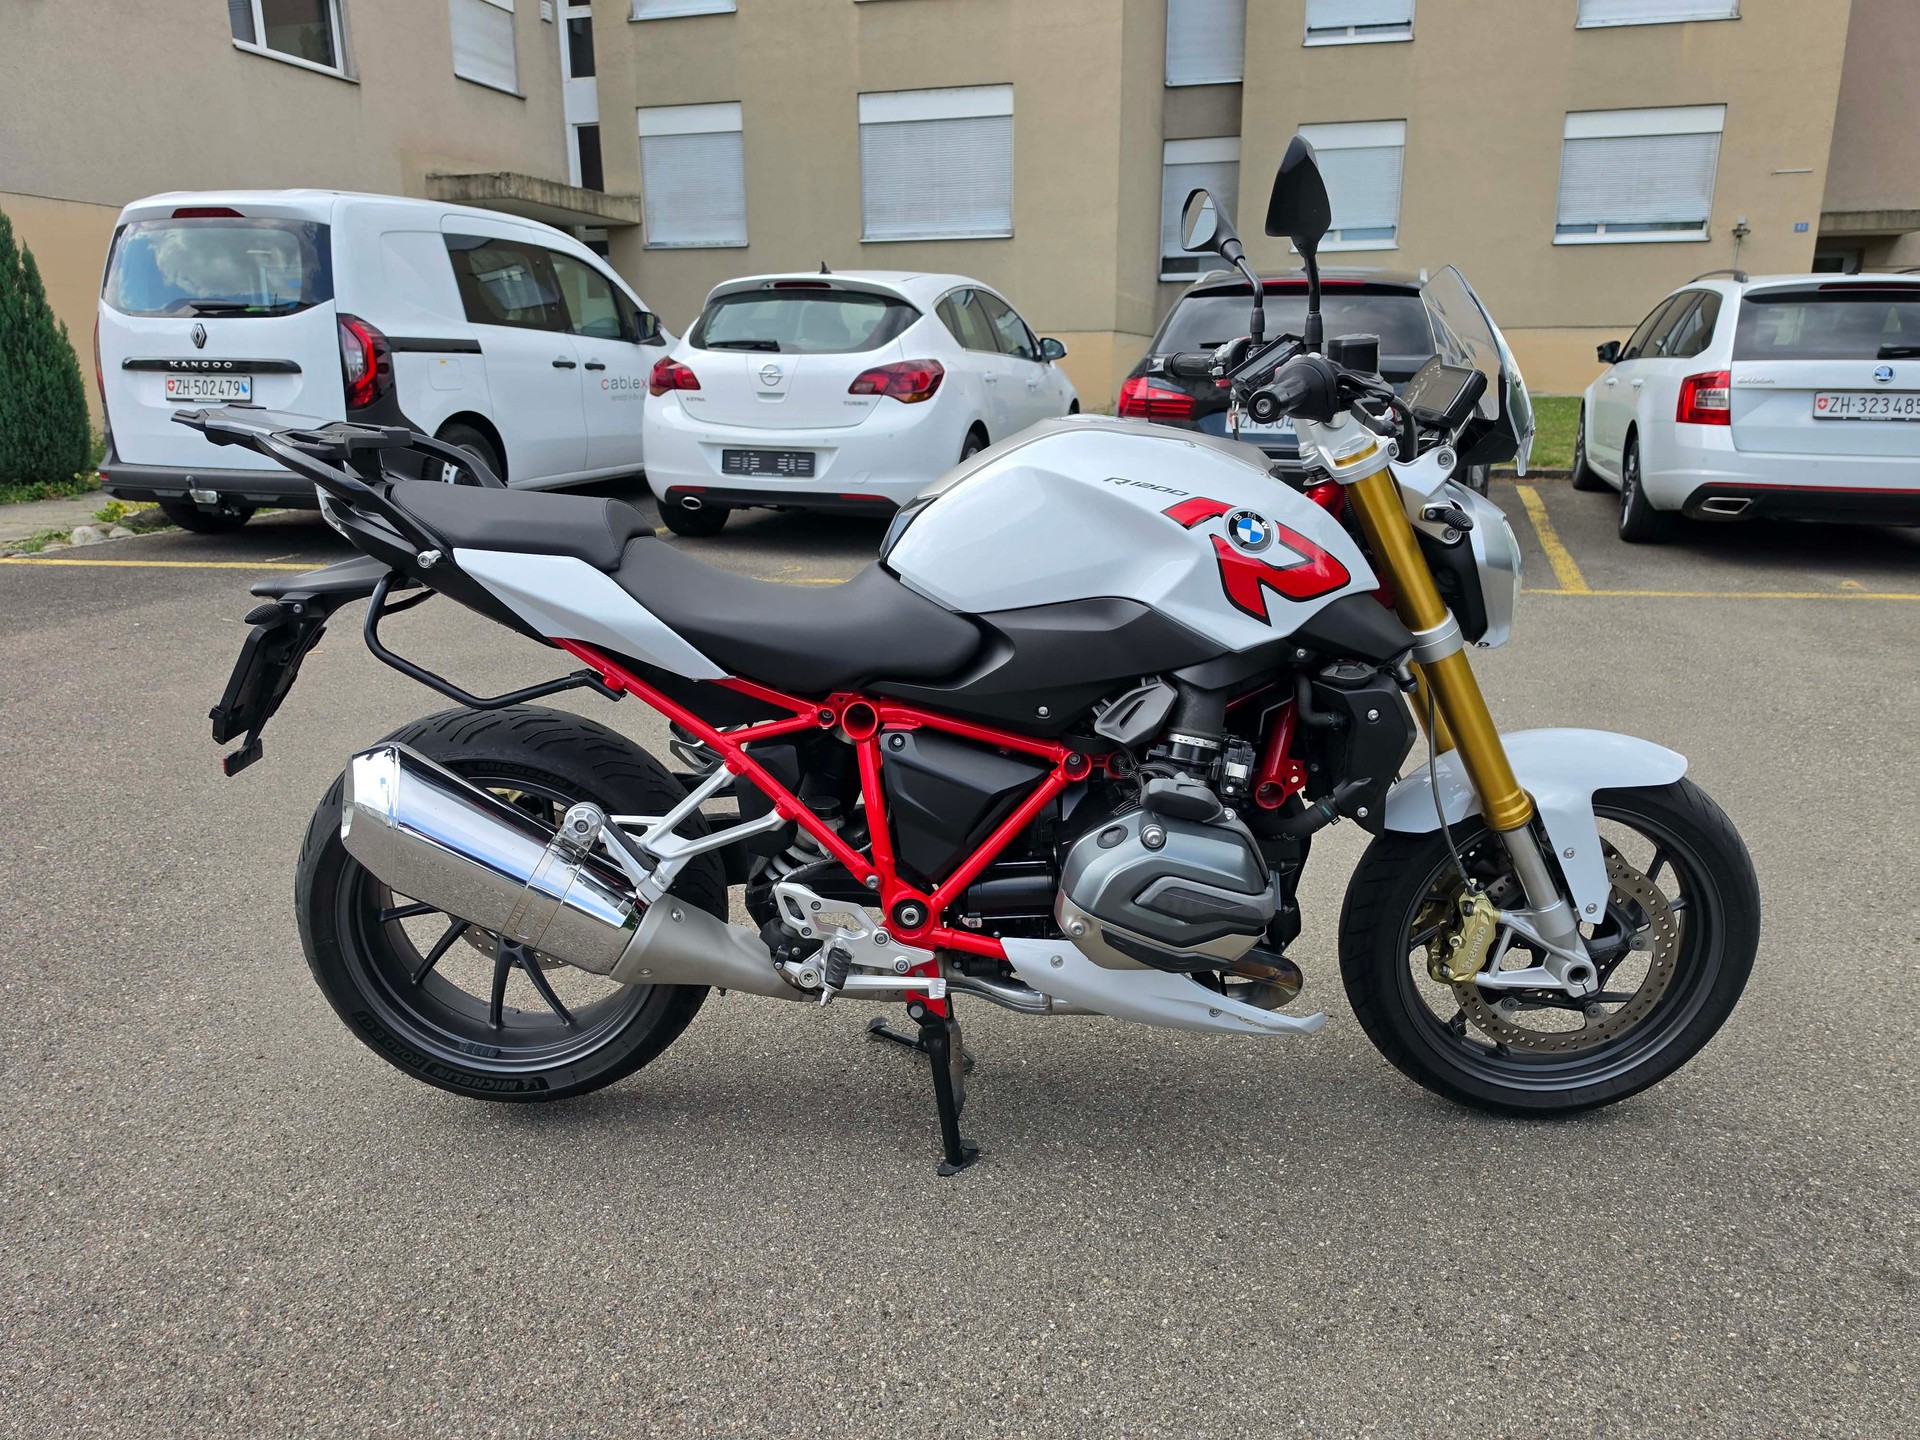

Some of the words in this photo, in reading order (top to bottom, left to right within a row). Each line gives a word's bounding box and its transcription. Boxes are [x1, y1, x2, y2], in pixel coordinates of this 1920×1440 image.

[169, 360, 233, 369] KANGOO
[601, 375, 648, 390] cablex
[433, 1066, 519, 1091] MICHELIN
